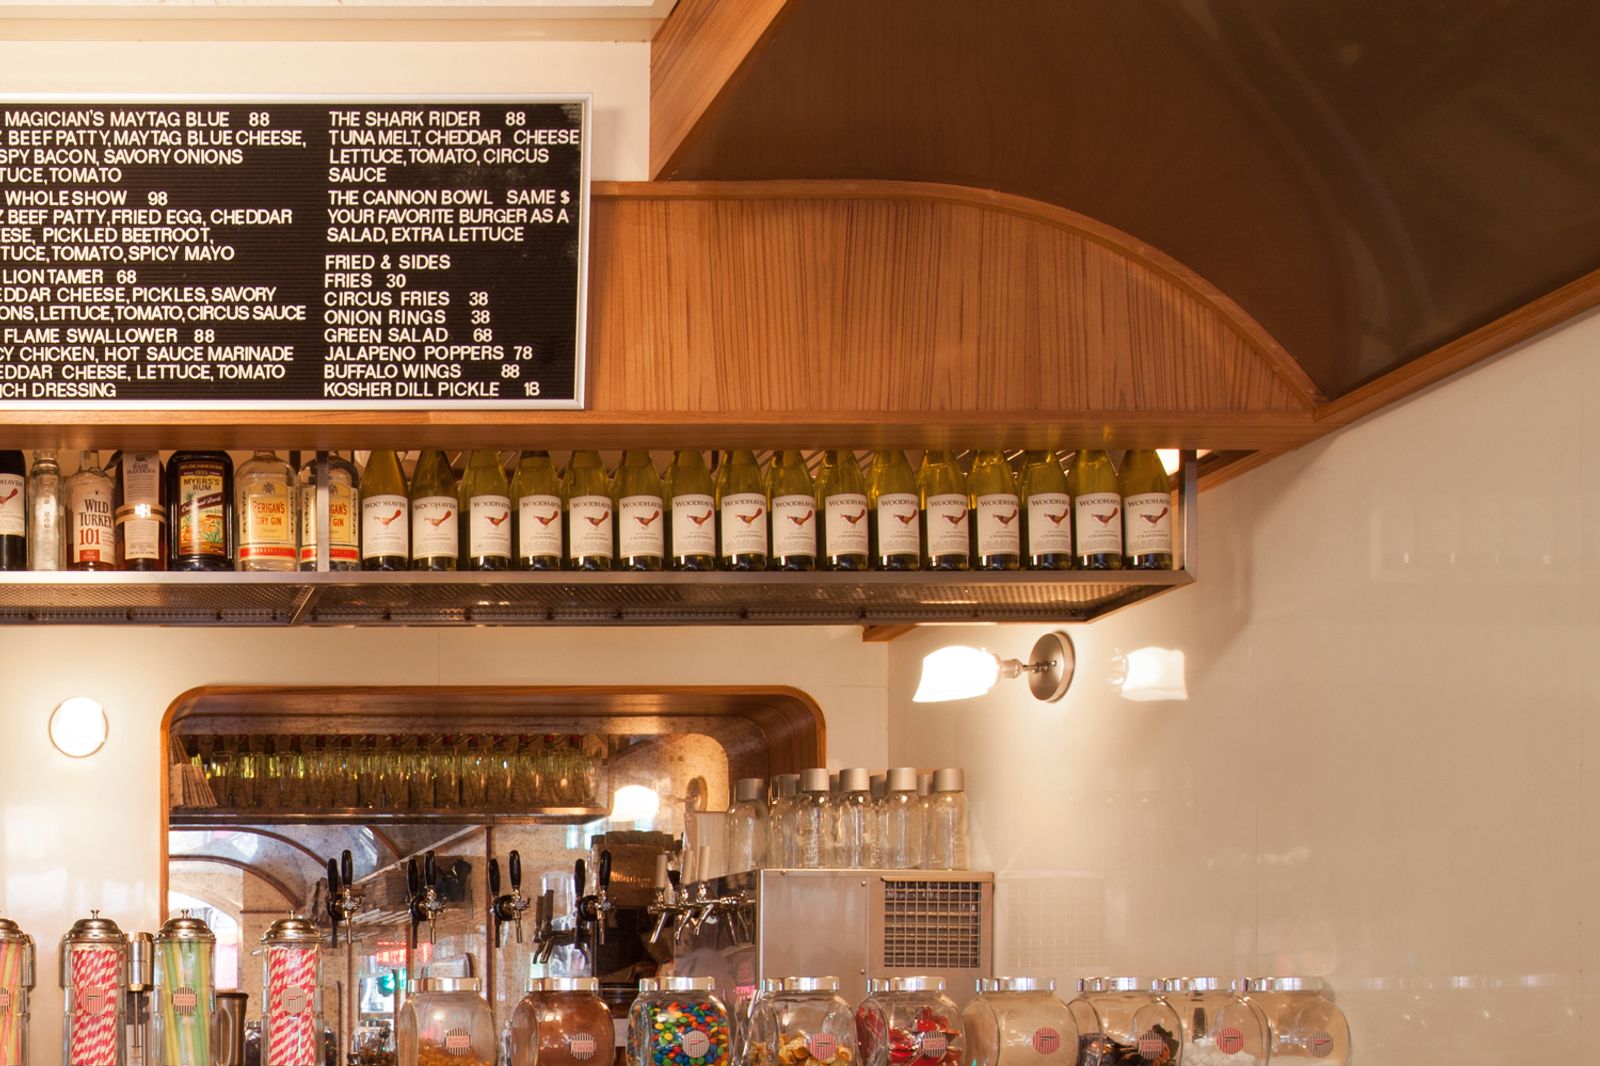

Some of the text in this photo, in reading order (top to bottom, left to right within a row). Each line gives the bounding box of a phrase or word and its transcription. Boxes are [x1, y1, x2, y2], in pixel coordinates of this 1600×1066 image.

[4, 109, 105, 128] MAGICIAN'S
[109, 110, 181, 128] MAYTAG
[185, 110, 230, 128] BLUE
[248, 111, 270, 127] 88
[328, 110, 526, 128] THE SHARK RIDER 88
[328, 129, 377, 146] TUNA
[425, 129, 502, 146] CHEDDAR
[513, 129, 580, 146] CHEESE
[103, 147, 172, 165] SAVORY
[173, 148, 244, 165] ONIONS
[483, 147, 550, 164] CIRCUS
[328, 166, 387, 183] SAUCE
[4, 189, 70, 207] WHOLE
[71, 189, 128, 207] SHOW
[147, 190, 169, 207] 98
[327, 189, 570, 206] THE CANNON BOWL SAME $
[327, 207, 570, 225] YOUR FAVORITE BURGER AS A
[42, 225, 119, 244] PICKLED
[391, 226, 445, 243] EXTRA
[448, 226, 525, 242] LETTUCE
[325, 253, 451, 271] FRIED & SIDES
[116, 269, 137, 285] 68
[324, 272, 407, 289] FRIES 30
[323, 290, 489, 307] CIRCUS FRIES 38
[323, 309, 491, 326] ONION RINGS 38
[4, 327, 60, 344] FLAME
[65, 327, 178, 345] SWALLOWER
[193, 328, 216, 344] 88
[323, 327, 493, 344] GREEN SALAD 68
[104, 345, 141, 362] HOT
[145, 345, 204, 362] SAUCE
[207, 345, 294, 362] MARINADE
[324, 345, 533, 362] JALAPENO POPPERS 78
[216, 363, 286, 380] TOMATO
[323, 363, 520, 380] BUFFALO WINGS 88
[31, 381, 117, 398] DRESSING
[323, 381, 540, 397] KOSHER DILL PICKLE 18
[183, 477, 221, 486] MYERS'S
[84, 499, 109, 514] WILD
[270, 516, 282, 526] GIN
[79, 528, 101, 545] 101
